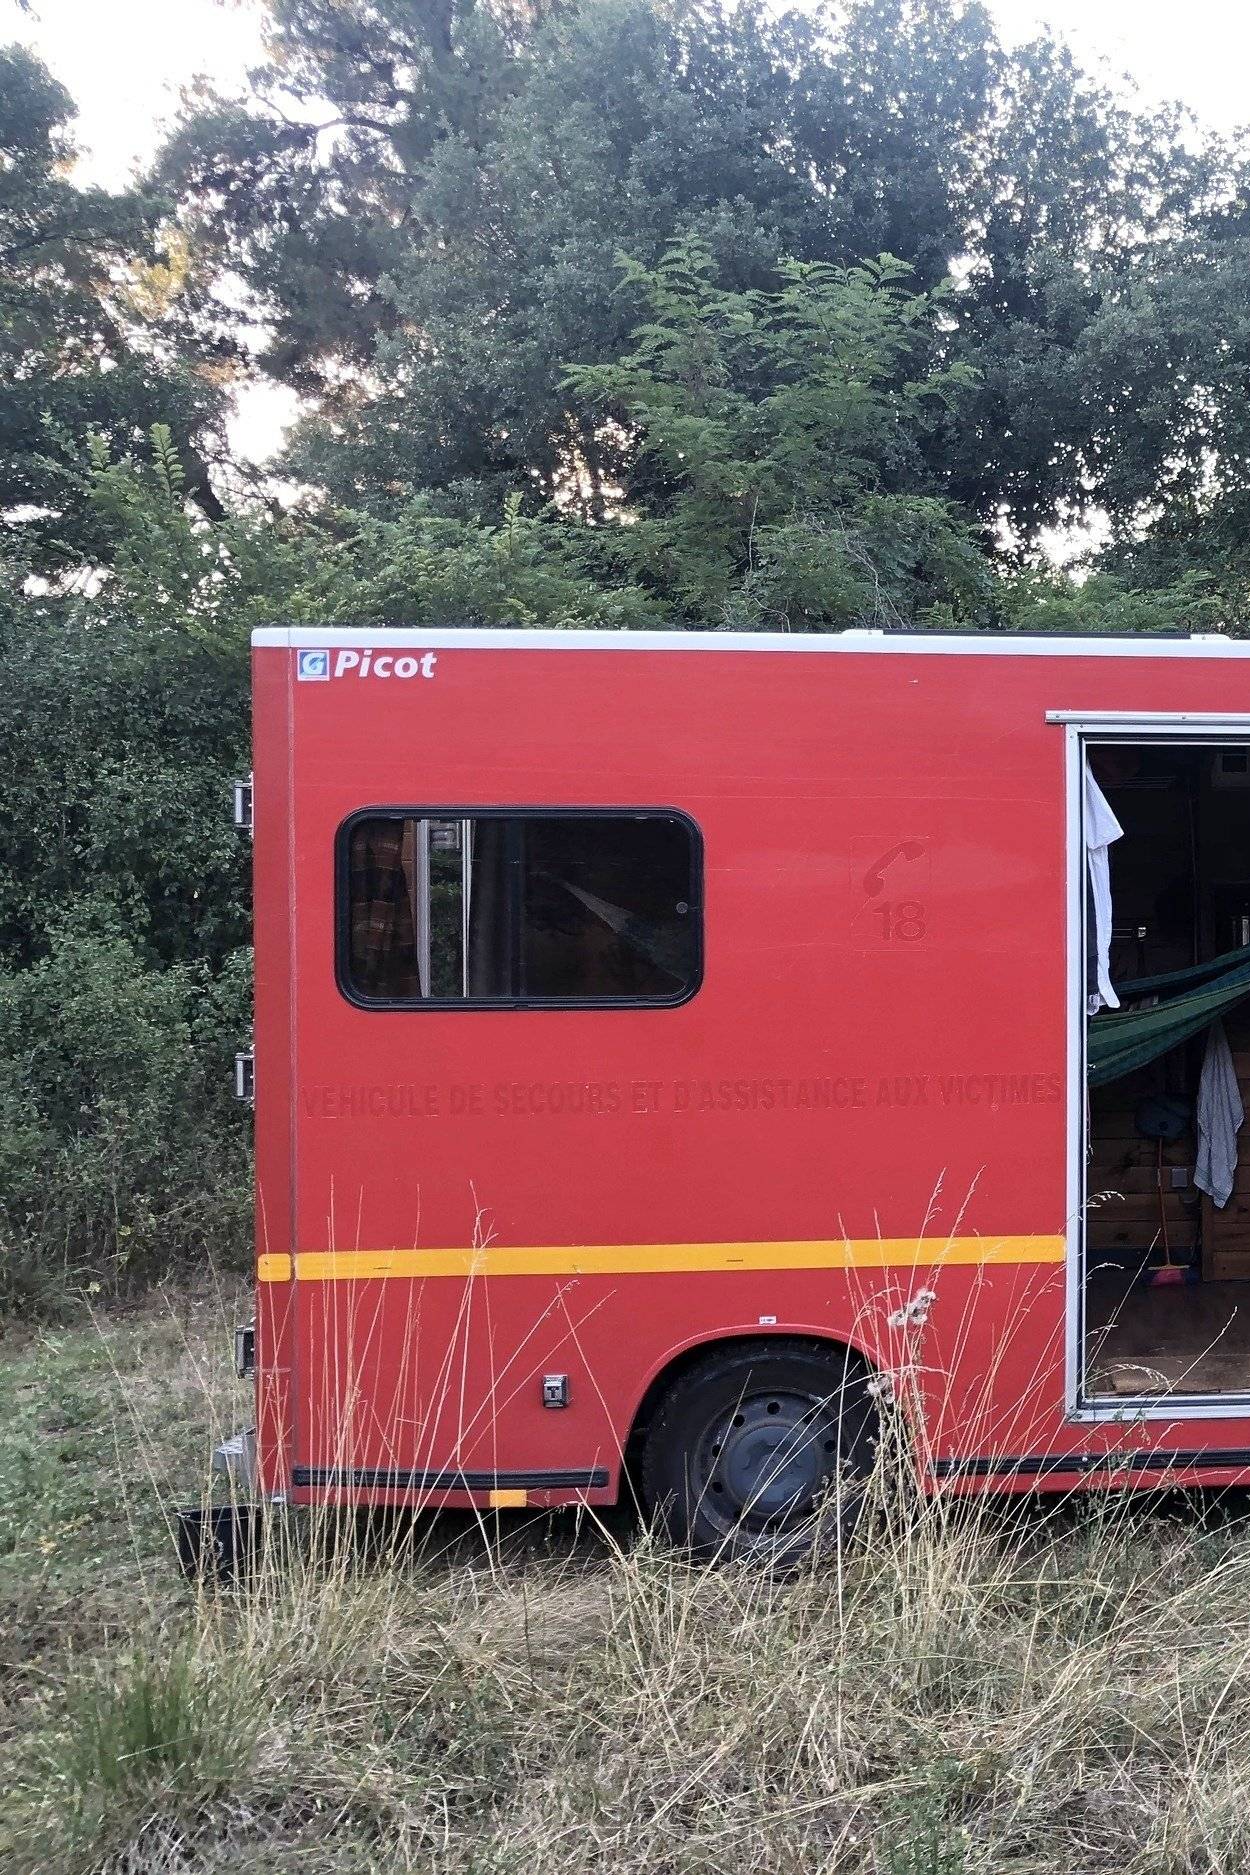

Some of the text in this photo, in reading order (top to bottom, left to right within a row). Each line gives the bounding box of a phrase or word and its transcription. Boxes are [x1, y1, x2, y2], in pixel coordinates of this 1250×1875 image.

[334, 650, 437, 678] Picot
[873, 900, 927, 942] 18
[449, 1083, 486, 1114] DE
[493, 1082, 622, 1114] SECOURS
[631, 1080, 664, 1112] ET
[876, 1075, 929, 1107] AUX
[938, 1073, 1062, 1105] VICTIMES
